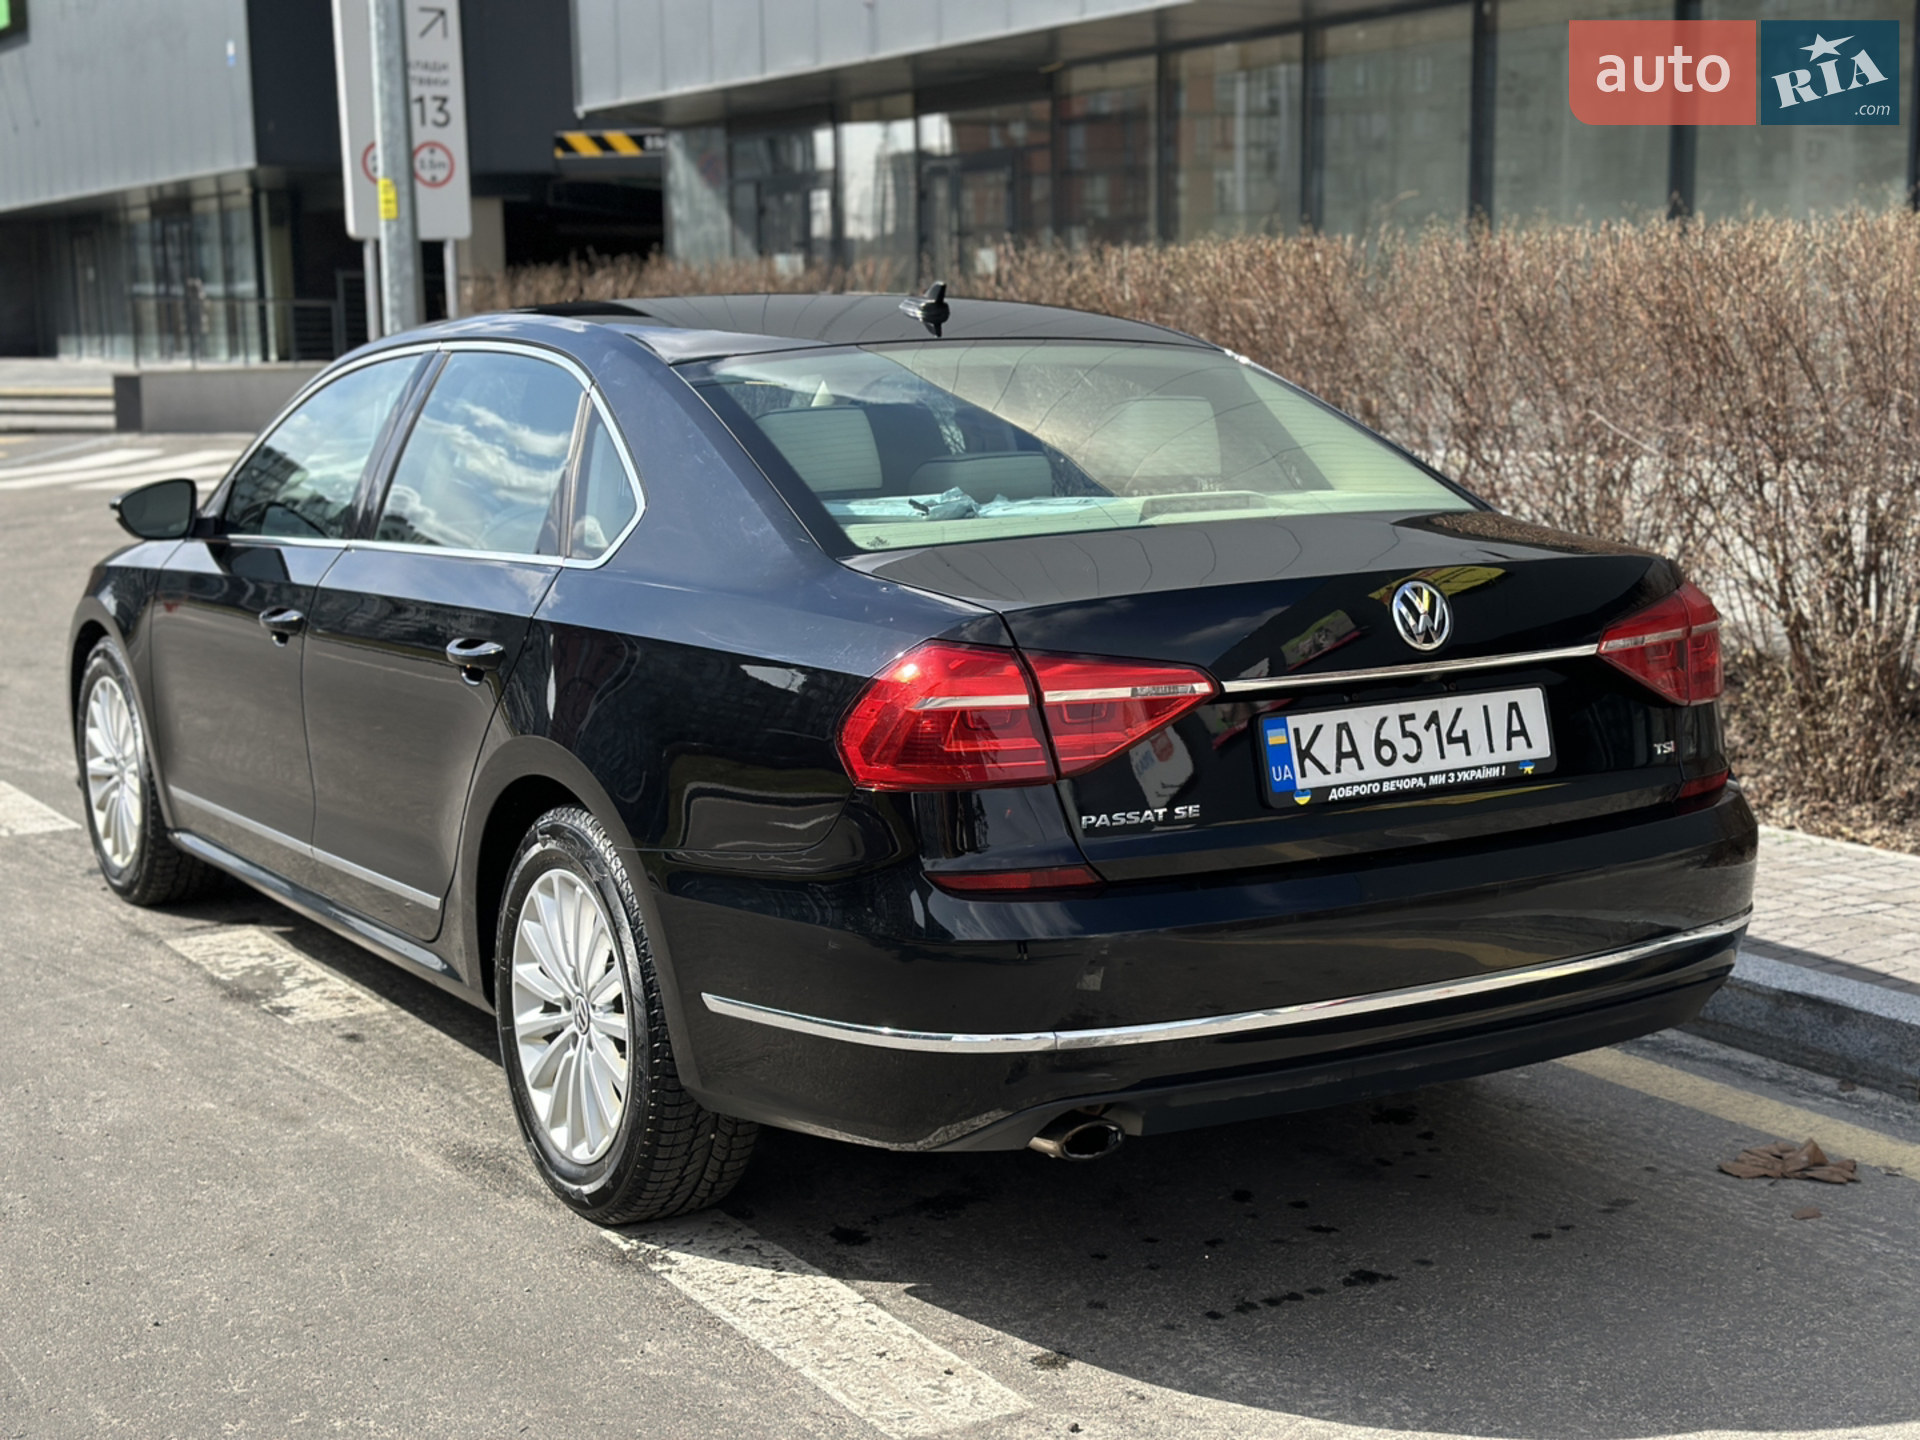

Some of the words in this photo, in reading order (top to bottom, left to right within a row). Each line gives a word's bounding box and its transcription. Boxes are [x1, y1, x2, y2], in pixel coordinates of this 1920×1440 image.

[412, 94, 451, 128] 13
[1373, 706, 1472, 767] 6514
[1653, 740, 1675, 755] TSI
[1271, 764, 1294, 782] UA
[1328, 782, 1381, 801] ДОБРОГО
[1382, 777, 1427, 792] ВЕЧОРА,
[1428, 773, 1446, 786] МИ
[1081, 807, 1168, 829] PASSAT
[1174, 804, 1200, 820] SE
